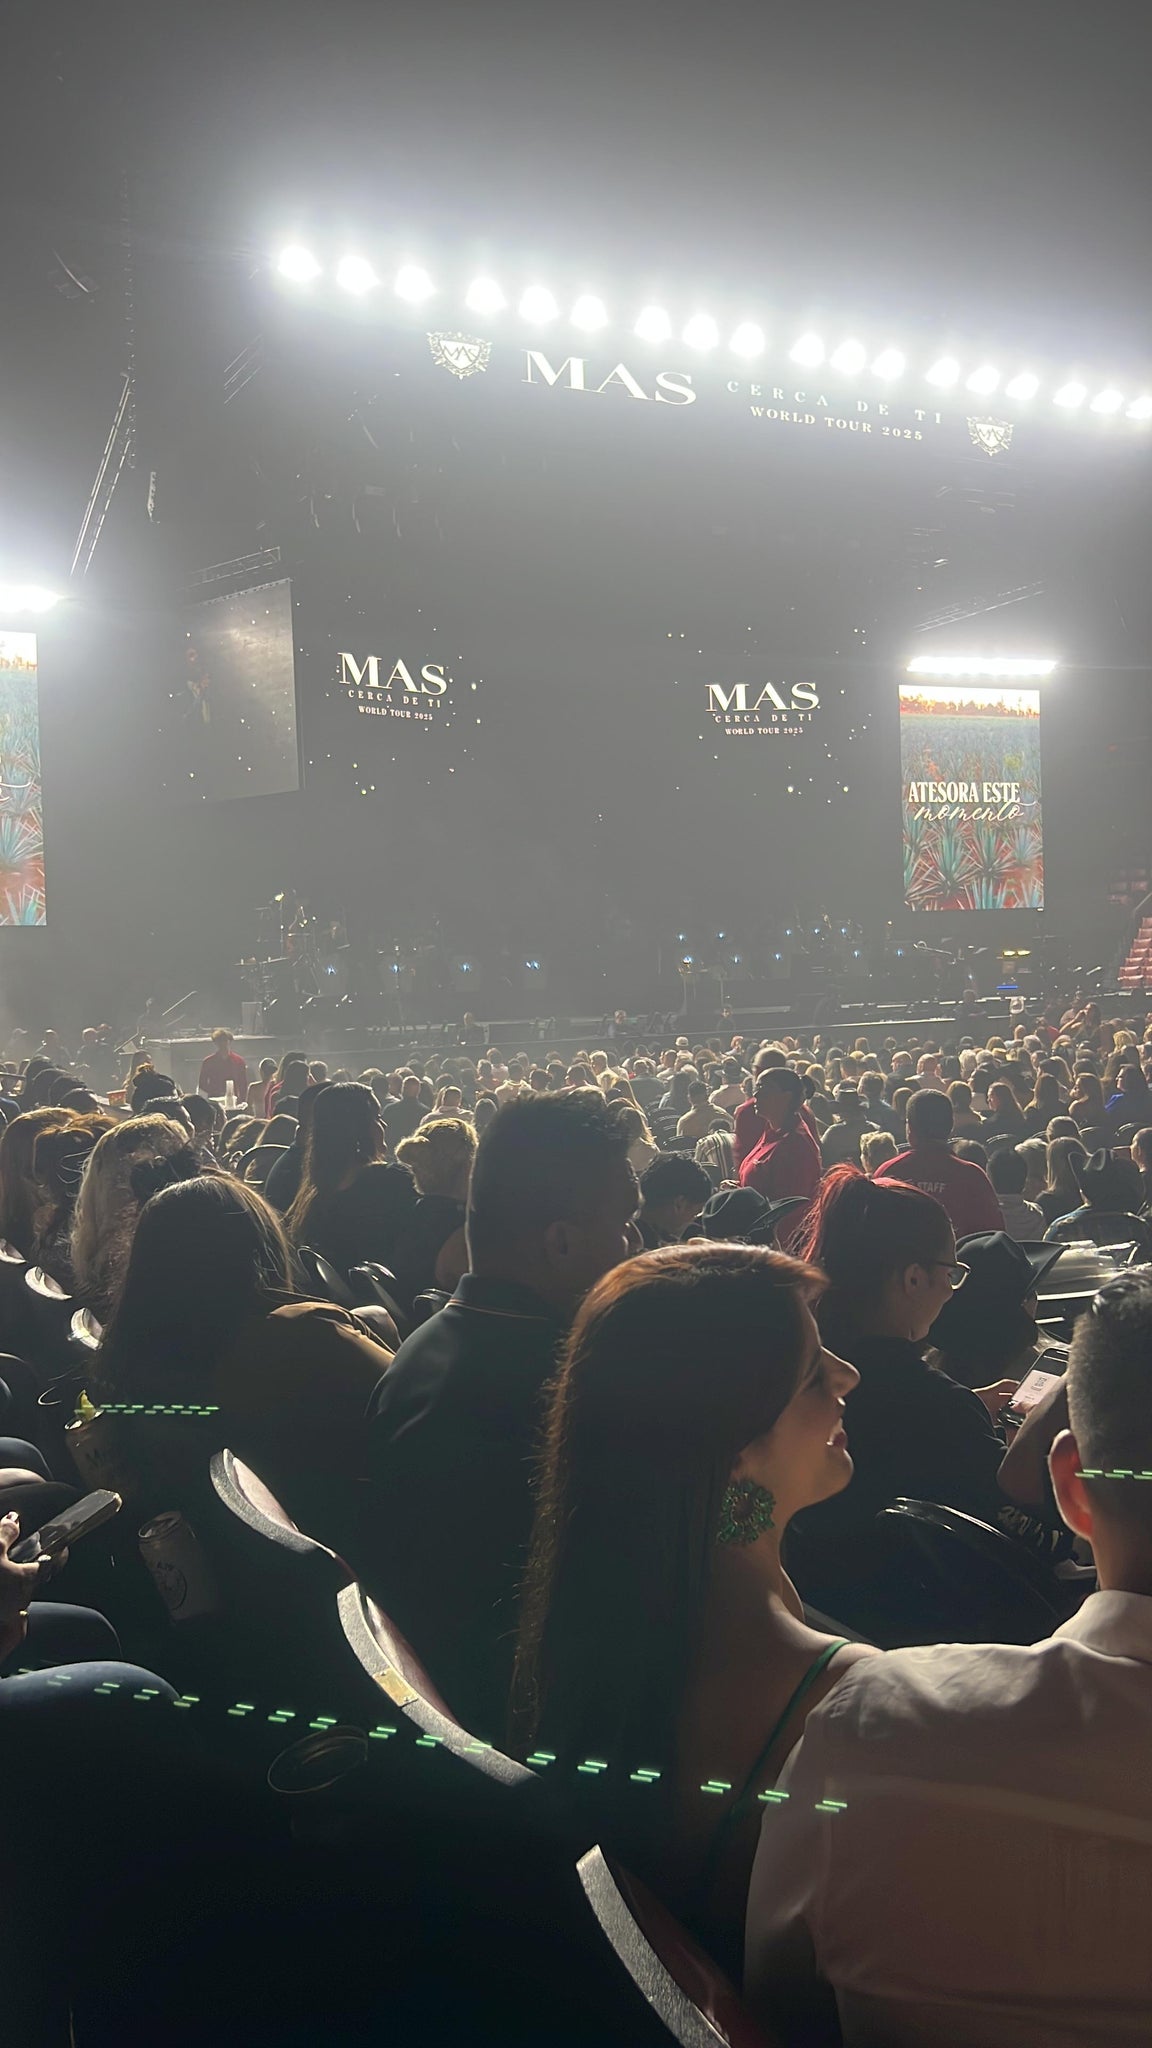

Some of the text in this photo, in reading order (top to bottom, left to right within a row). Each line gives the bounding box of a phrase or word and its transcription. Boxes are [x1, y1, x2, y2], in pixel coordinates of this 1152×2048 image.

[520, 349, 697, 406] MAS
[727, 380, 942, 424] CERCA DE TI
[750, 406, 923, 441] WORLD TOUR 2025
[337, 652, 448, 696] MAS
[348, 689, 441, 709] CERCA DE TI
[704, 681, 820, 712] MAS
[358, 705, 433, 721] WORLD TOUR 2025
[715, 713, 812, 723] CERCA DE TI
[725, 727, 755, 736] WORLD
[757, 727, 780, 735] TOUR
[908, 781, 1021, 803] ATESORA ESTE
[914, 801, 1037, 821] momento
